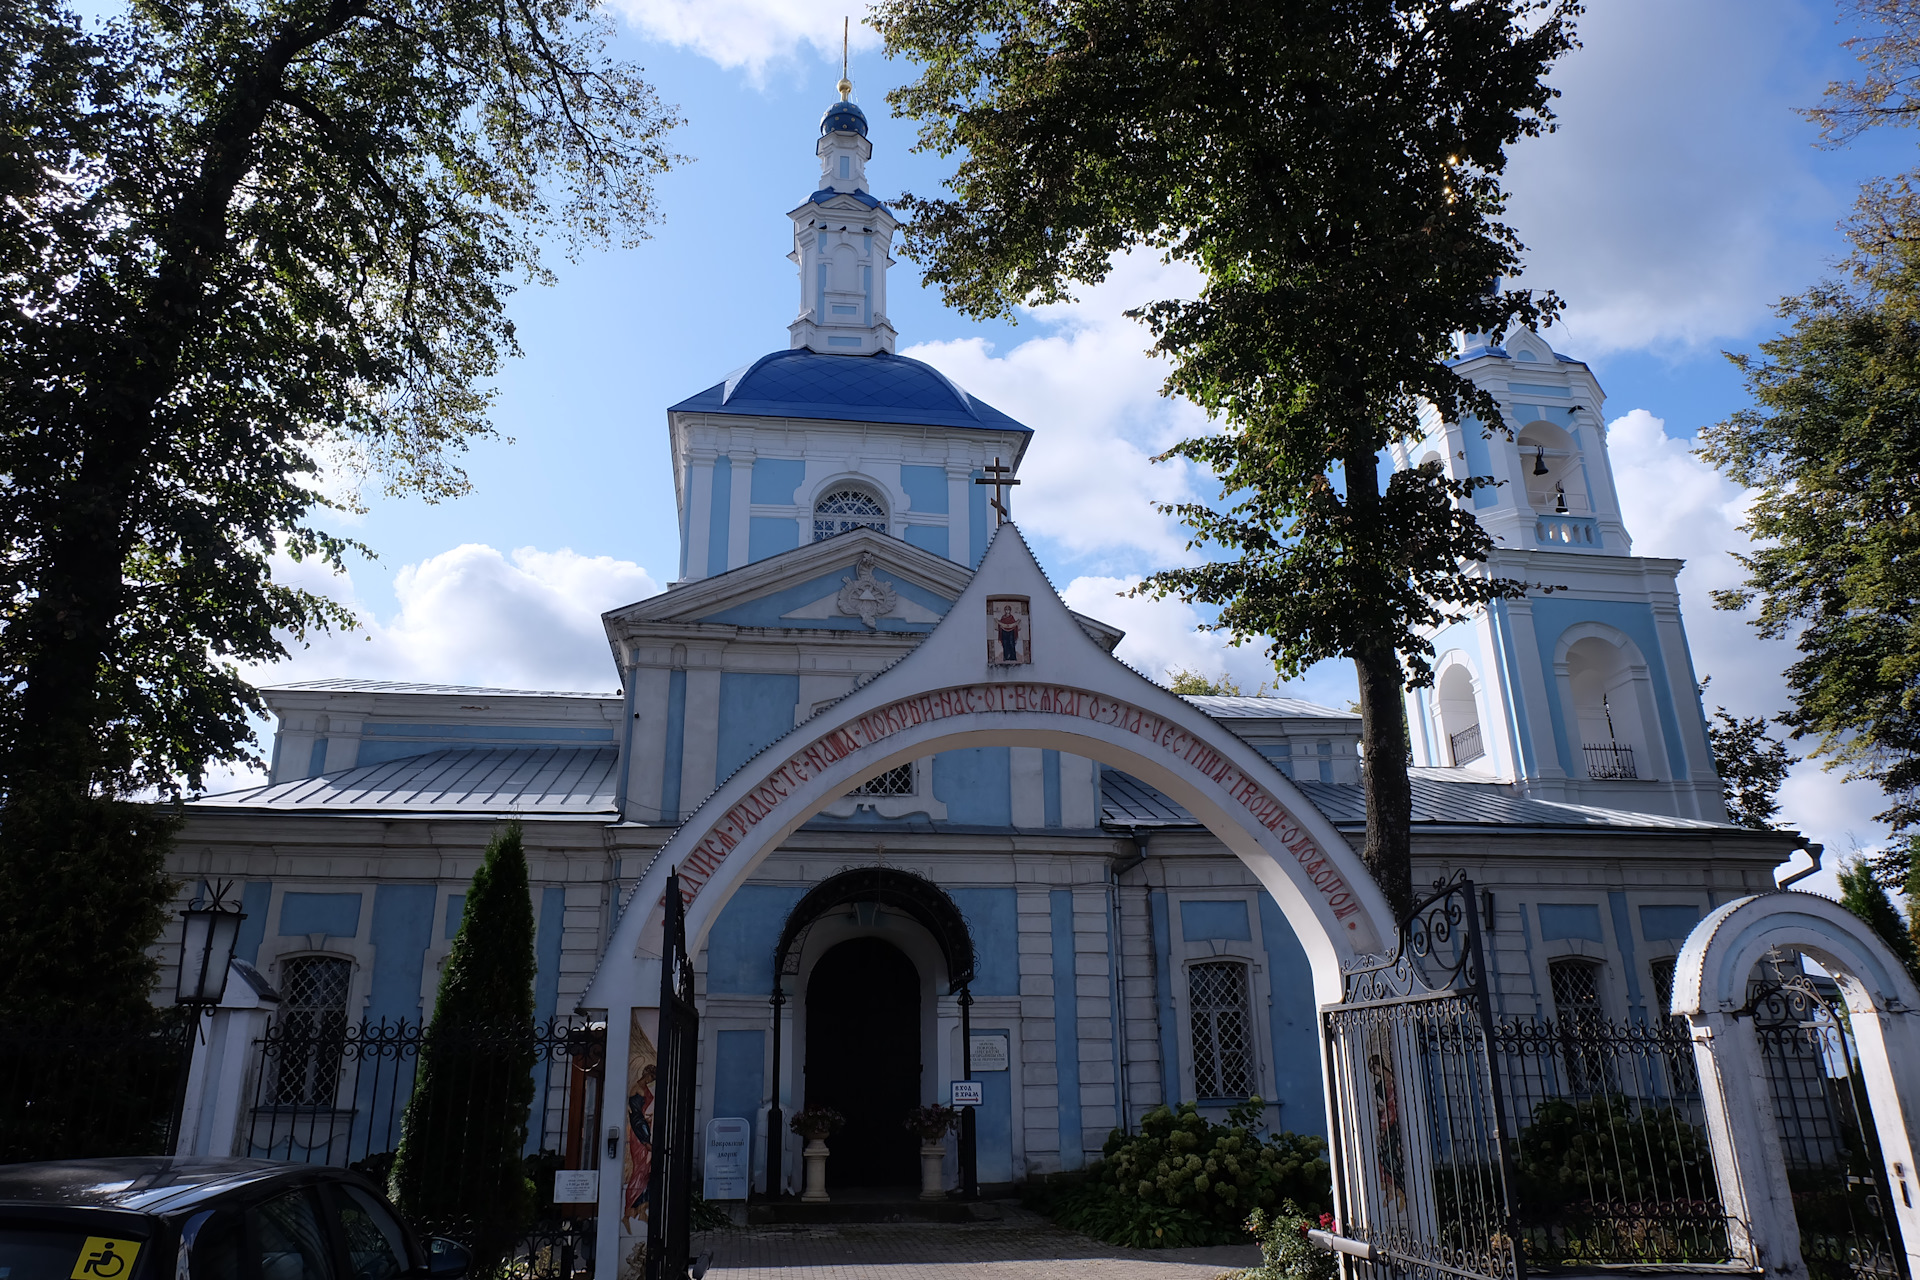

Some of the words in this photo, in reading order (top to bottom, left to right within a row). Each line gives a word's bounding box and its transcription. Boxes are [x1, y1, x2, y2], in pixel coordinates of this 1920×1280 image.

[728, 760, 808, 836] РАДОСТЕ
[807, 728, 861, 772] НАША
[939, 687, 975, 717] НАС
[985, 685, 1006, 711] ОТ
[1109, 703, 1143, 734] ЗЛА
[1229, 771, 1287, 831] ТВОИМ
[1282, 827, 1361, 919] ОМОФОРОМ
